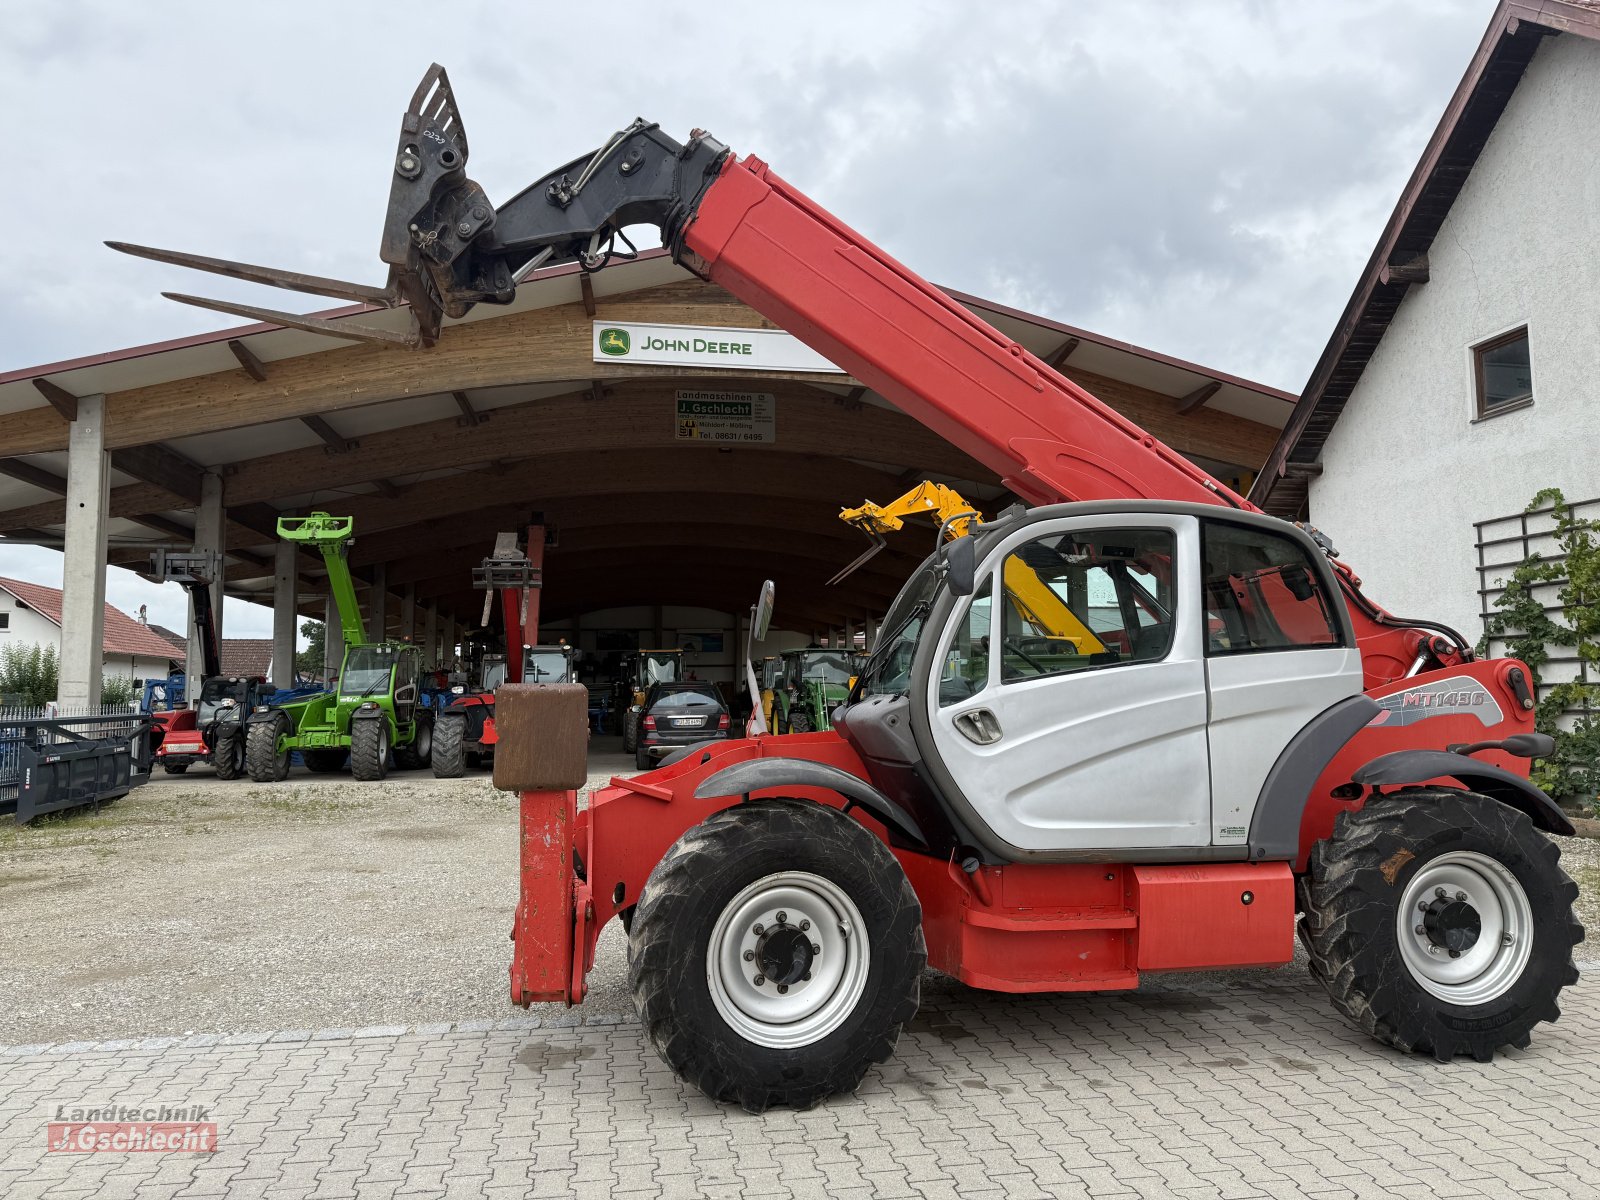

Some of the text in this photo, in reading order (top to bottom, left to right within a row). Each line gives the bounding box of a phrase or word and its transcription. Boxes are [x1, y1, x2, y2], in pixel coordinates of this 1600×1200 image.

[641, 336, 752, 355] JOHN DEERE
[677, 391, 752, 401] Landmaschinen
[693, 403, 750, 414] Gschlecht
[698, 431, 713, 440] Tel.
[743, 433, 763, 441] 6495
